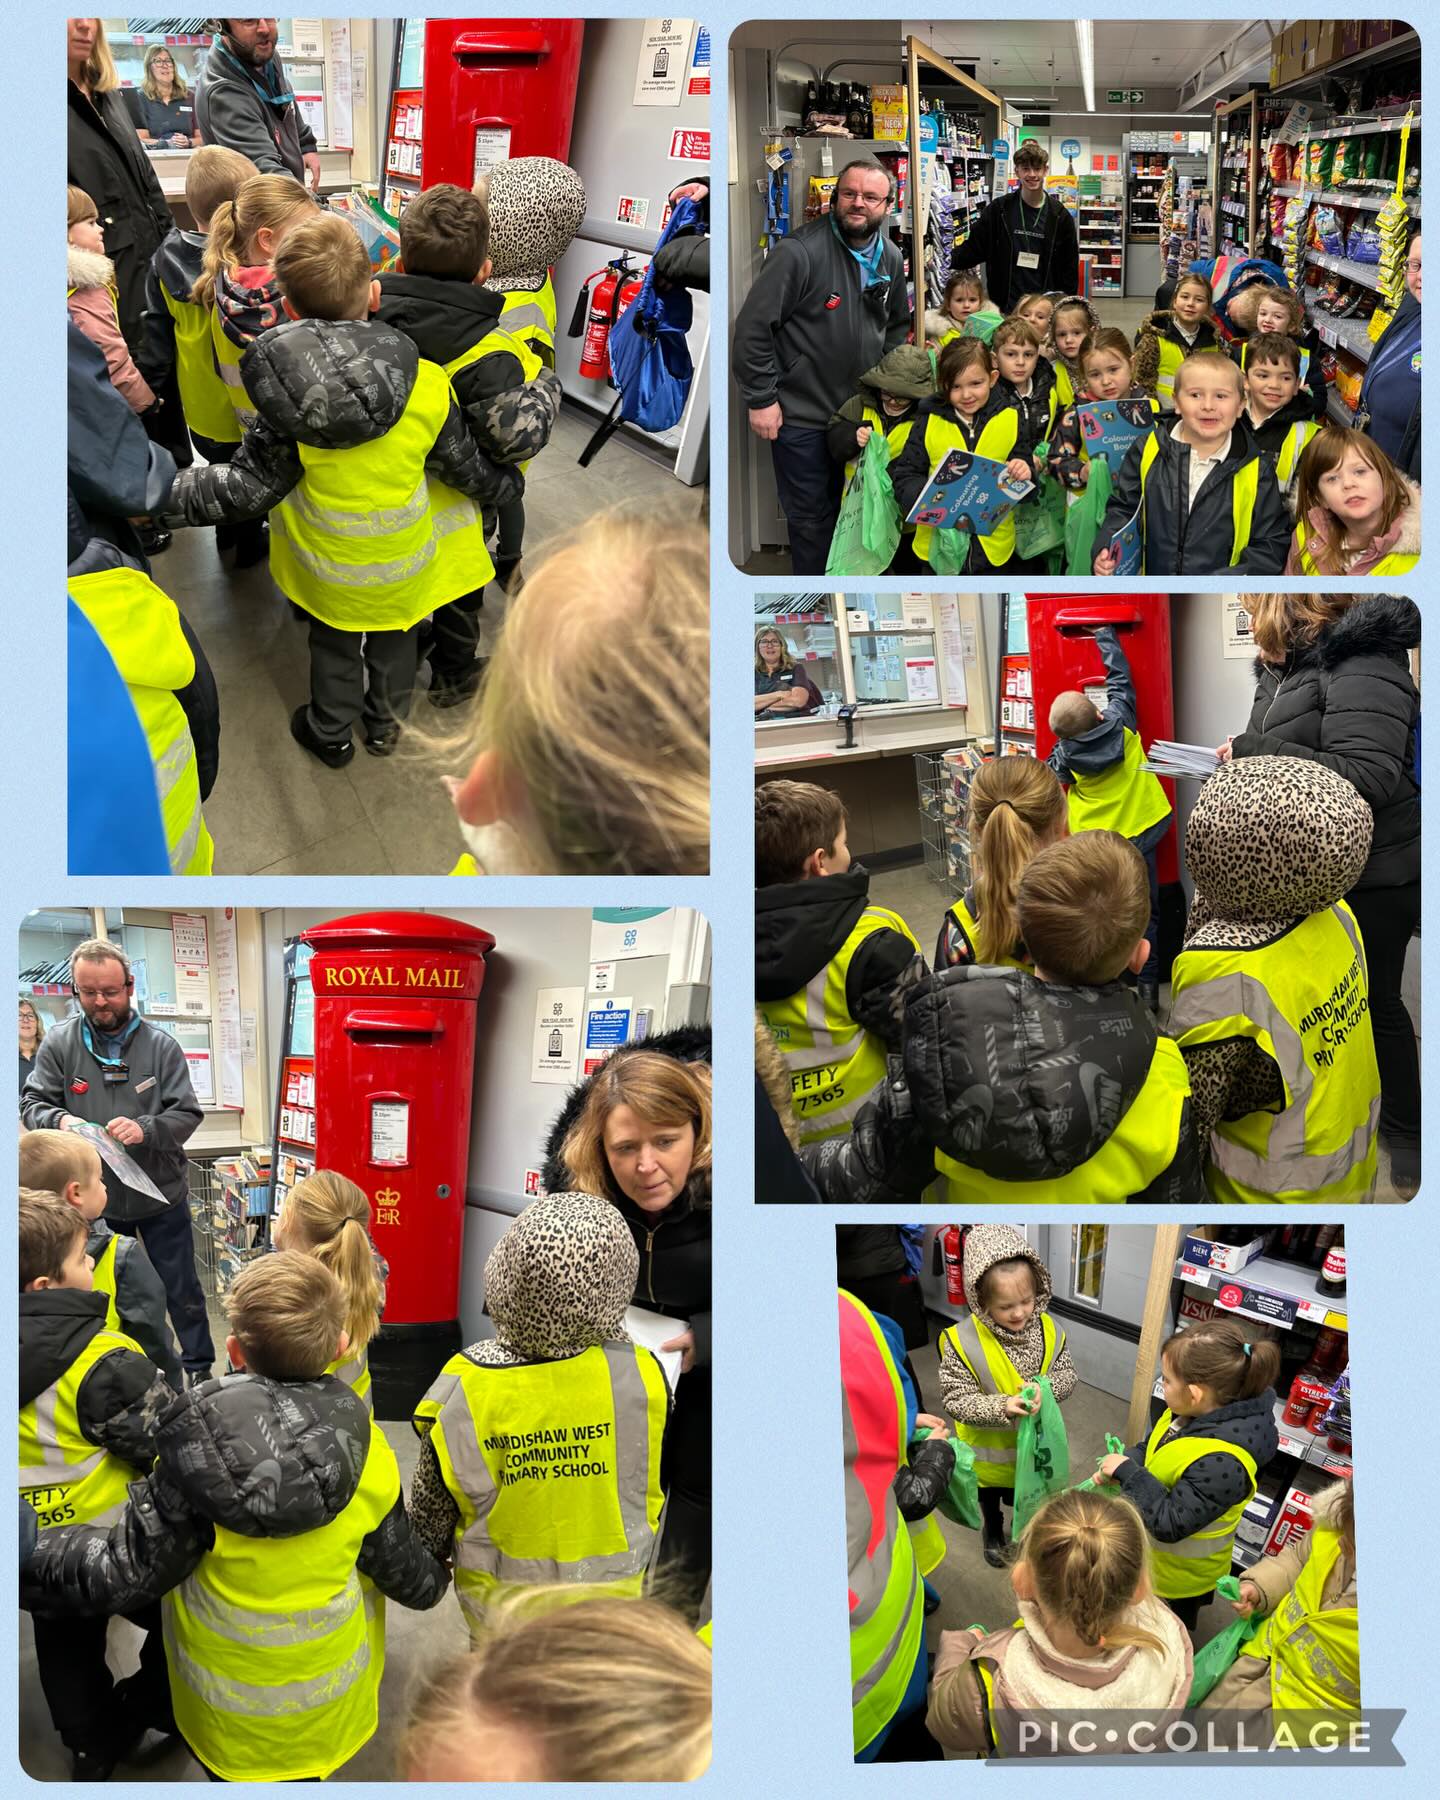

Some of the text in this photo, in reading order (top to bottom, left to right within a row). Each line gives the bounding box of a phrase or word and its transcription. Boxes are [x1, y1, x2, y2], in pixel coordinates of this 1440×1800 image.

[950, 474, 979, 513] Colouring
[962, 485, 980, 506] Book
[324, 966, 465, 989] ROYAL MAIL
[590, 1011, 627, 1020] Fire action
[791, 1065, 840, 1093] FETY
[796, 1082, 845, 1112] 7365
[483, 1422, 611, 1451] MURDISHAW WEST
[505, 1444, 590, 1469] COMMUNITY
[553, 1461, 609, 1479] SCHOOL
